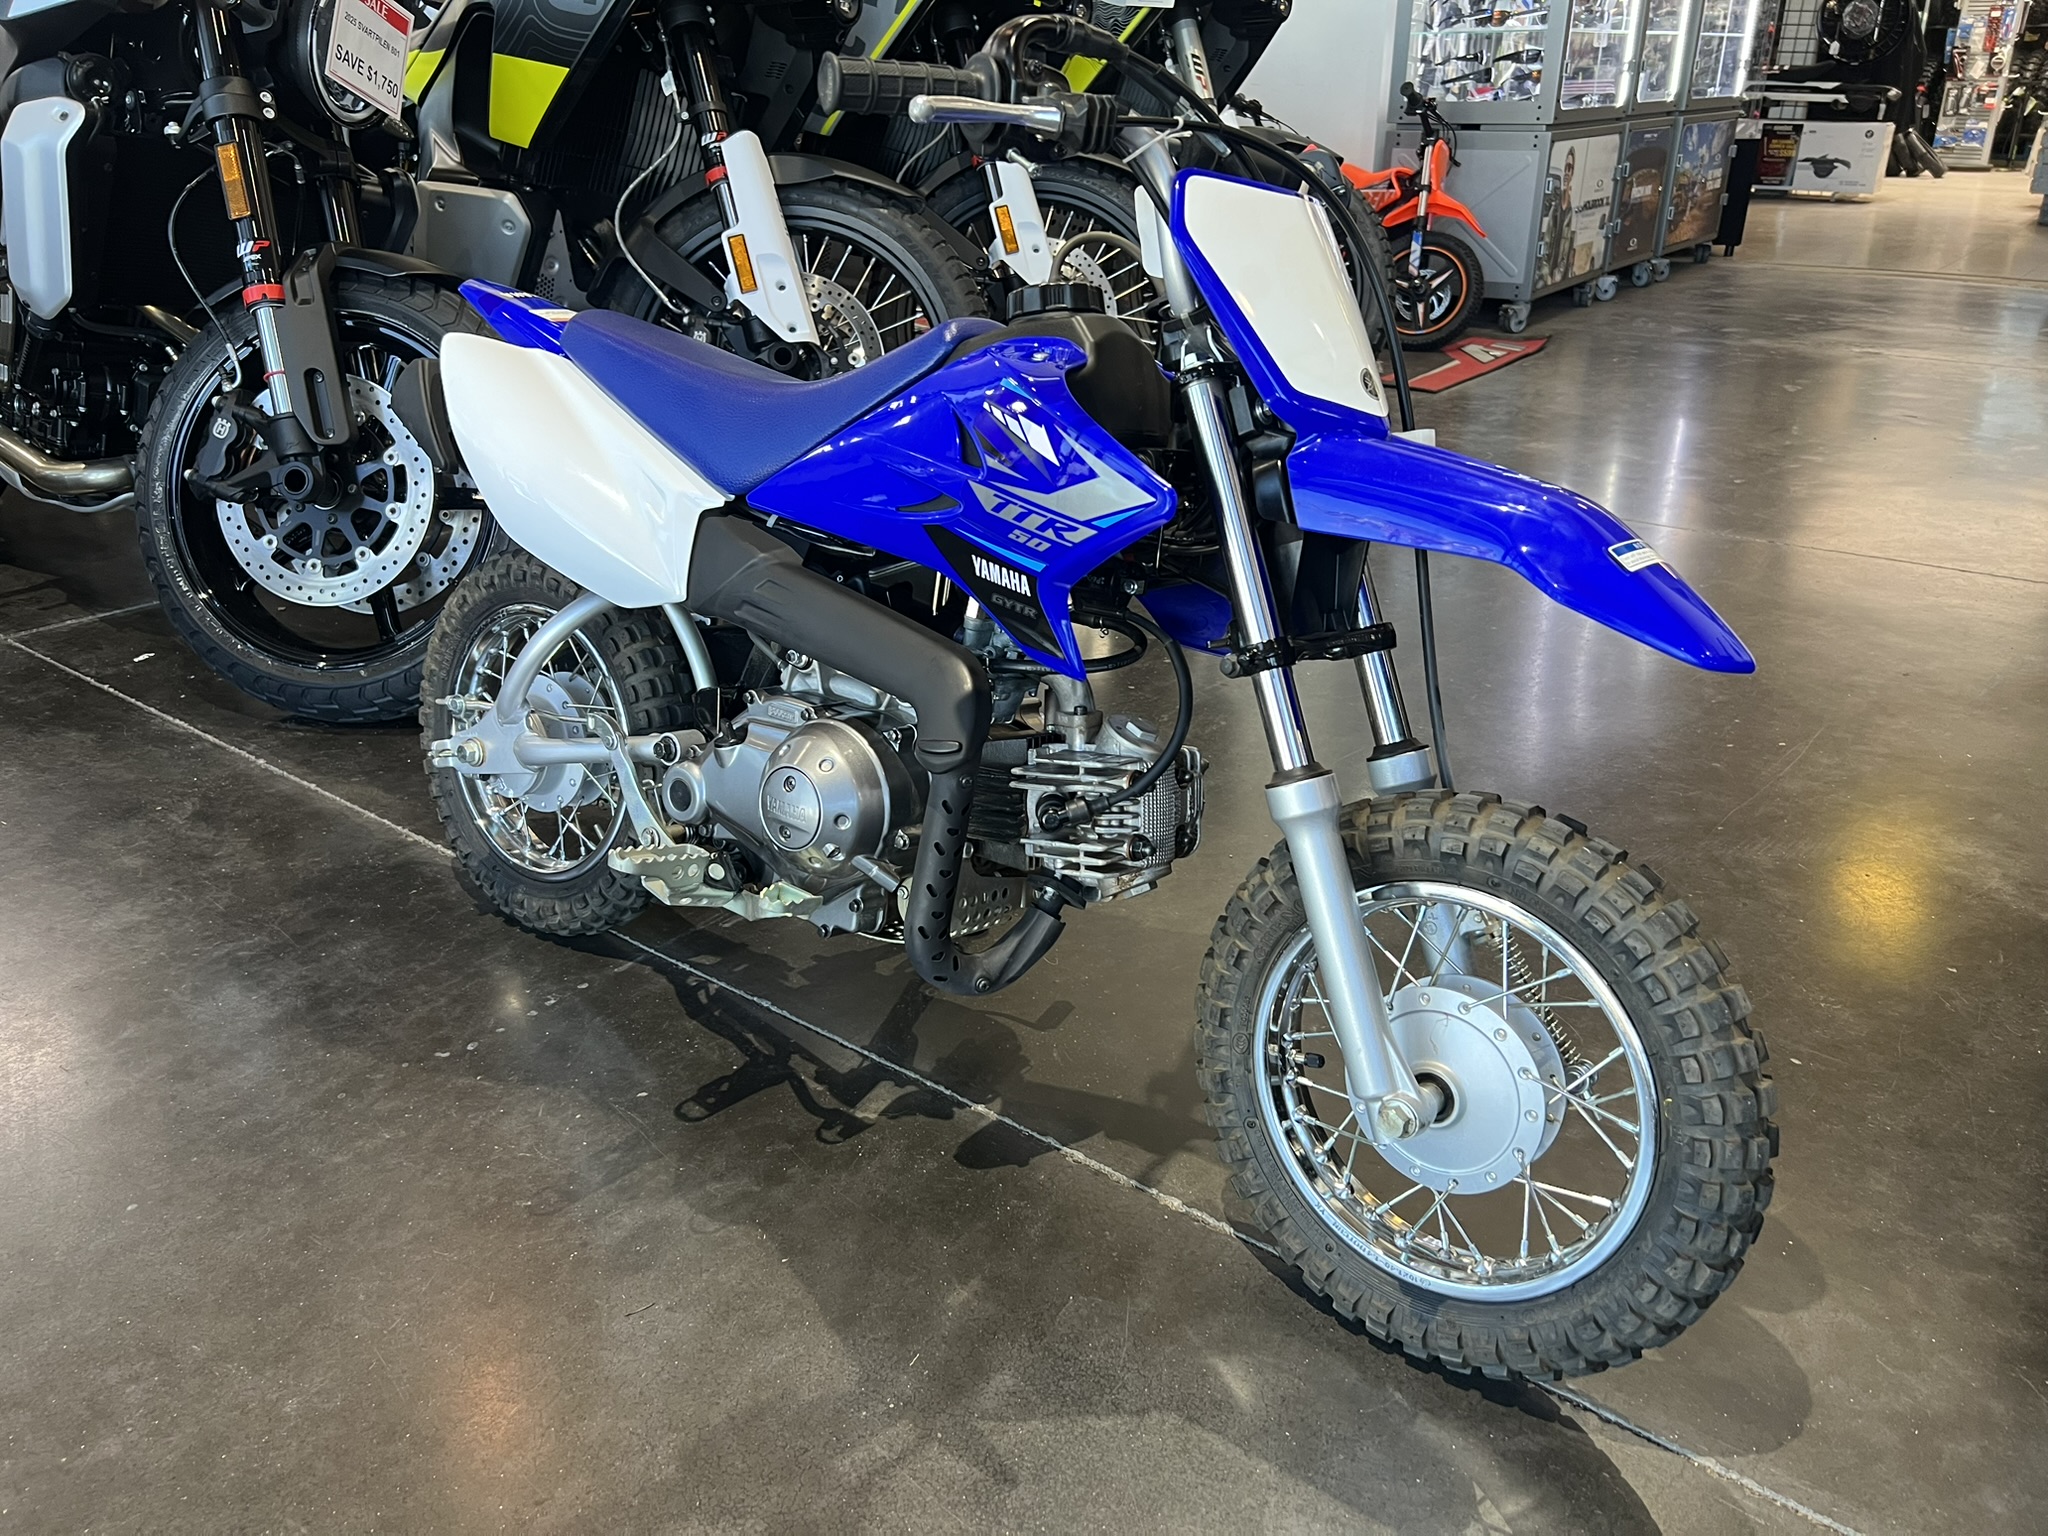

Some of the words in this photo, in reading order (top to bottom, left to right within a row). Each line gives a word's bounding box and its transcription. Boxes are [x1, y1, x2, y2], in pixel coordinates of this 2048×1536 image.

[344, 11, 357, 27] 2025
[362, 0, 389, 20] SALE
[335, 43, 365, 76] SAVE
[366, 65, 399, 98] $1,750
[701, 131, 727, 146] WP
[236, 240, 270, 258] WP
[990, 493, 1080, 541] TTR
[1007, 528, 1052, 552] 50
[971, 554, 1031, 597] YAMAHA
[991, 592, 1038, 620] GYTR
[766, 794, 807, 823] YAMAHA
